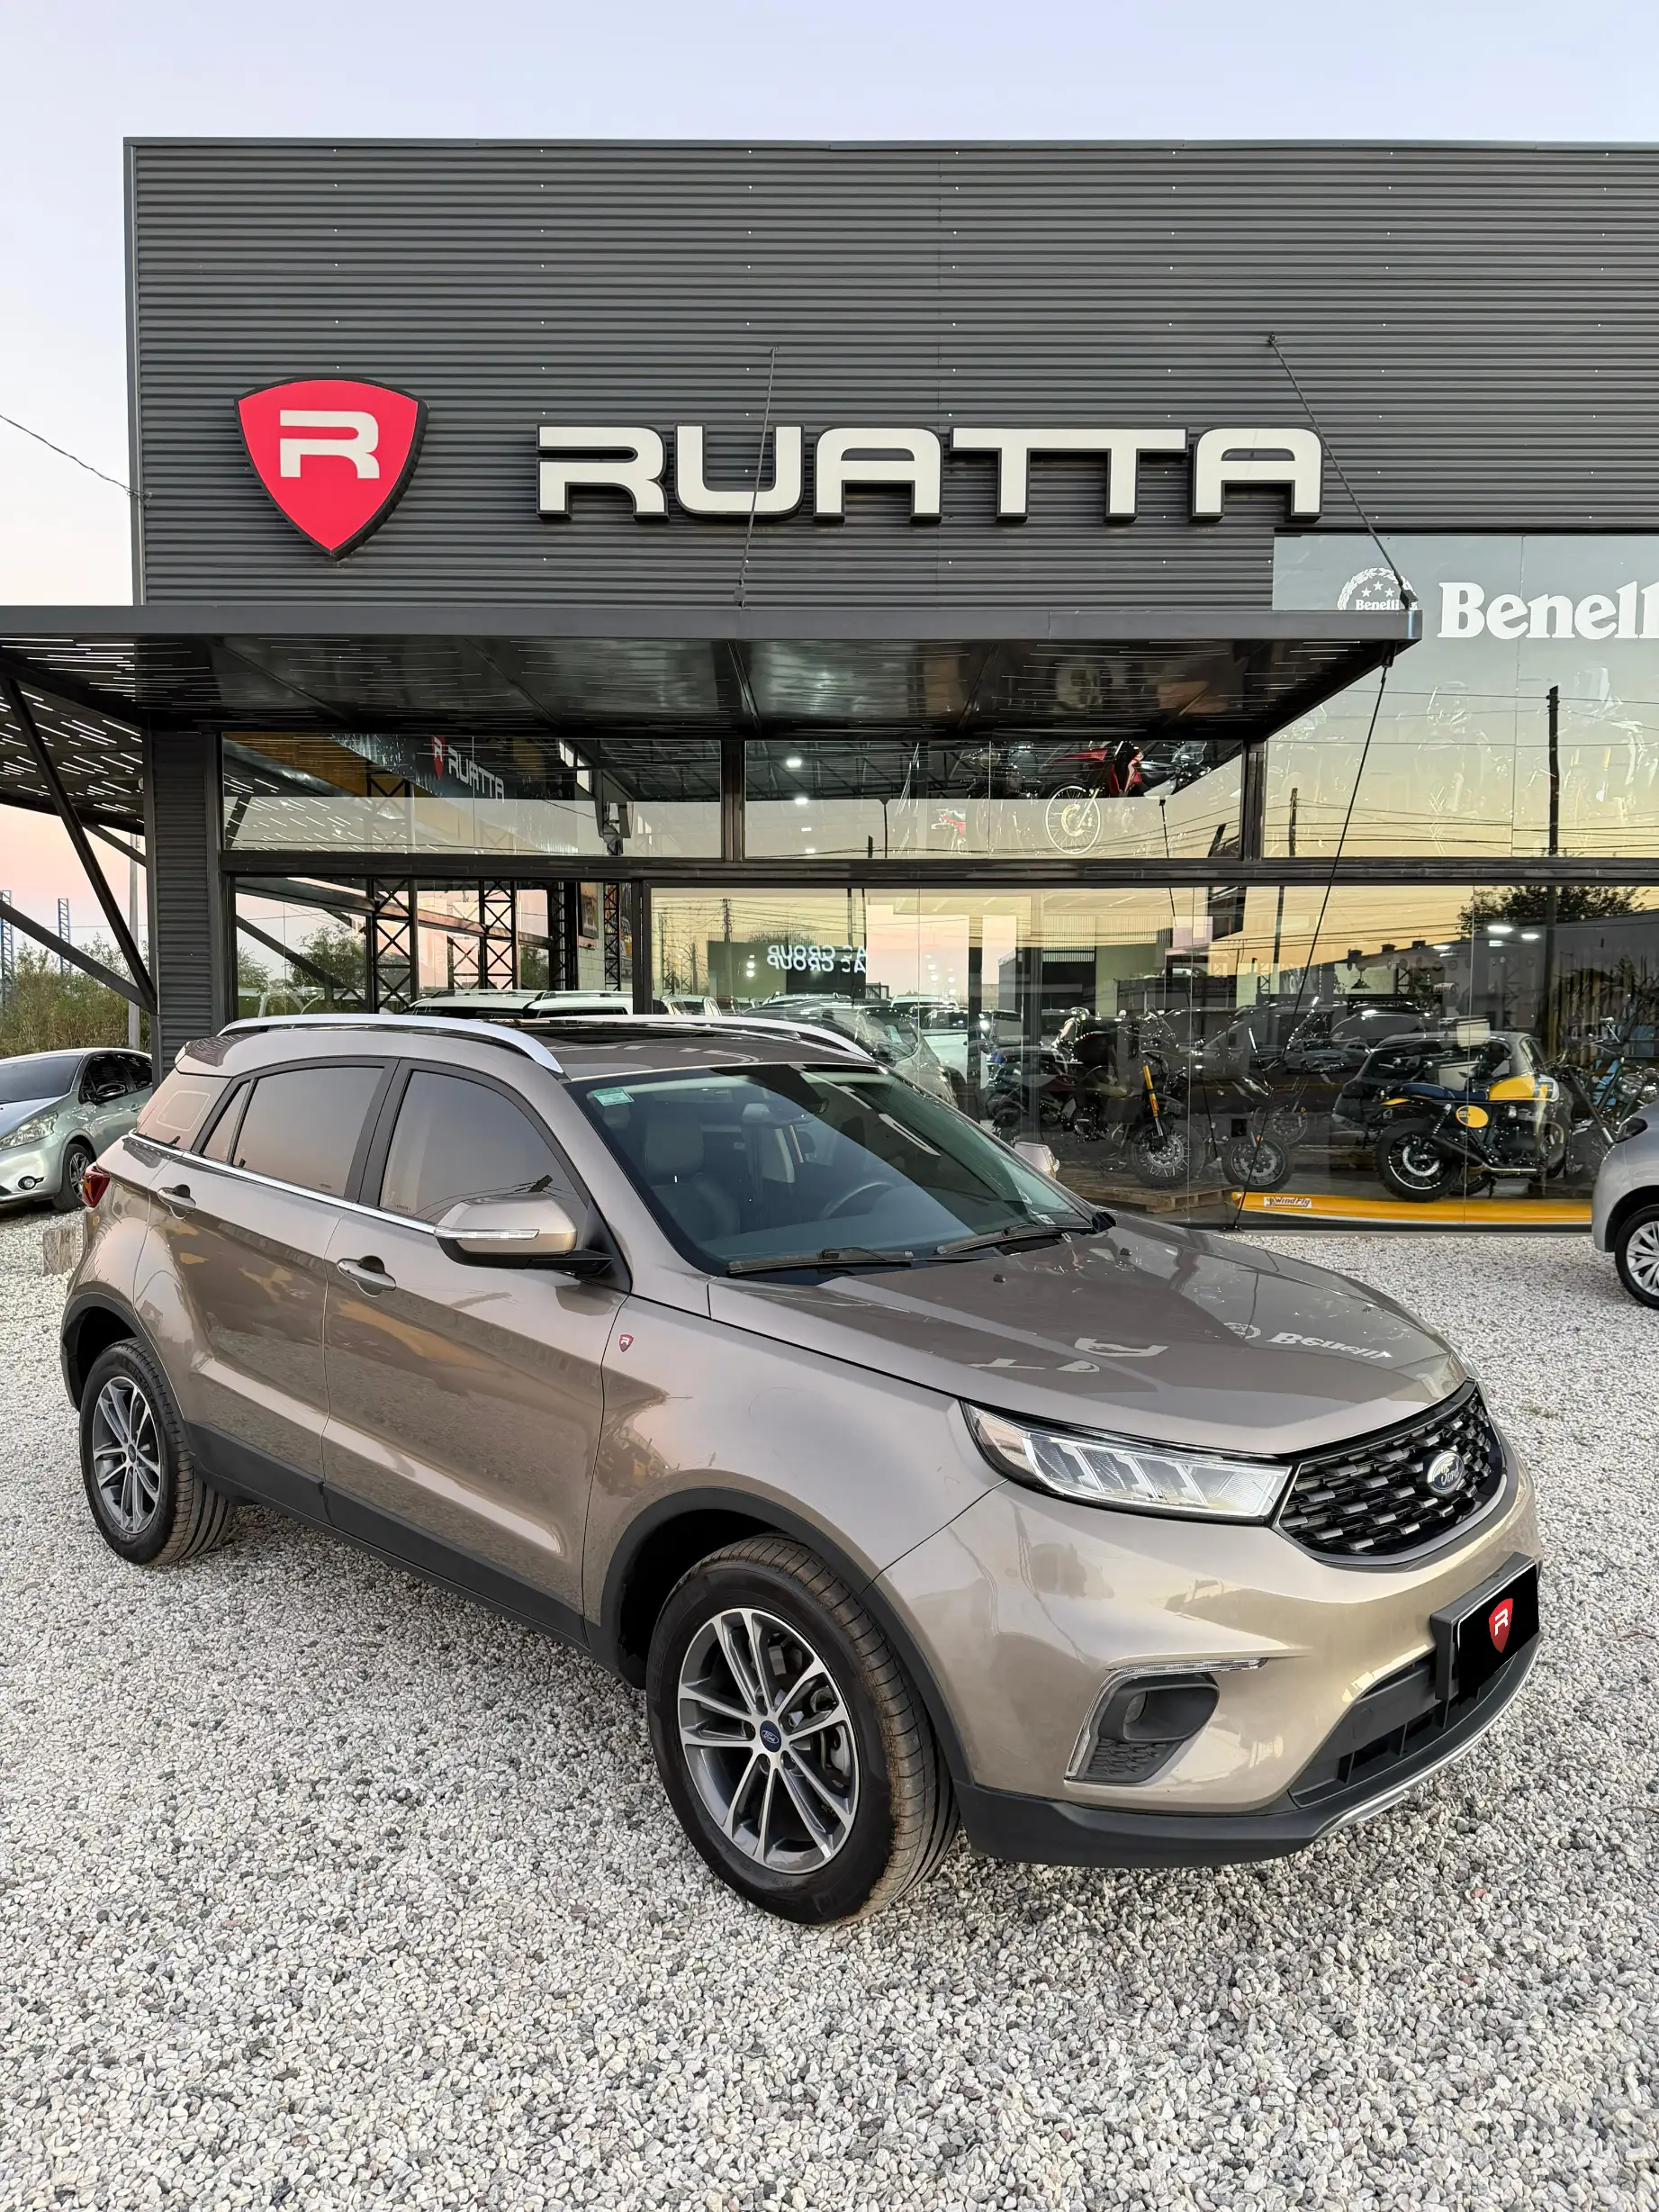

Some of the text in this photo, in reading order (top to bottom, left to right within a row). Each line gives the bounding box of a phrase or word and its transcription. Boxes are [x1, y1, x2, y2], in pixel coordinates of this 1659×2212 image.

[280, 410, 380, 479] R
[537, 425, 1322, 514] RUATTA
[1355, 599, 1400, 610] Benelli
[447, 745, 505, 804] RUATTA
